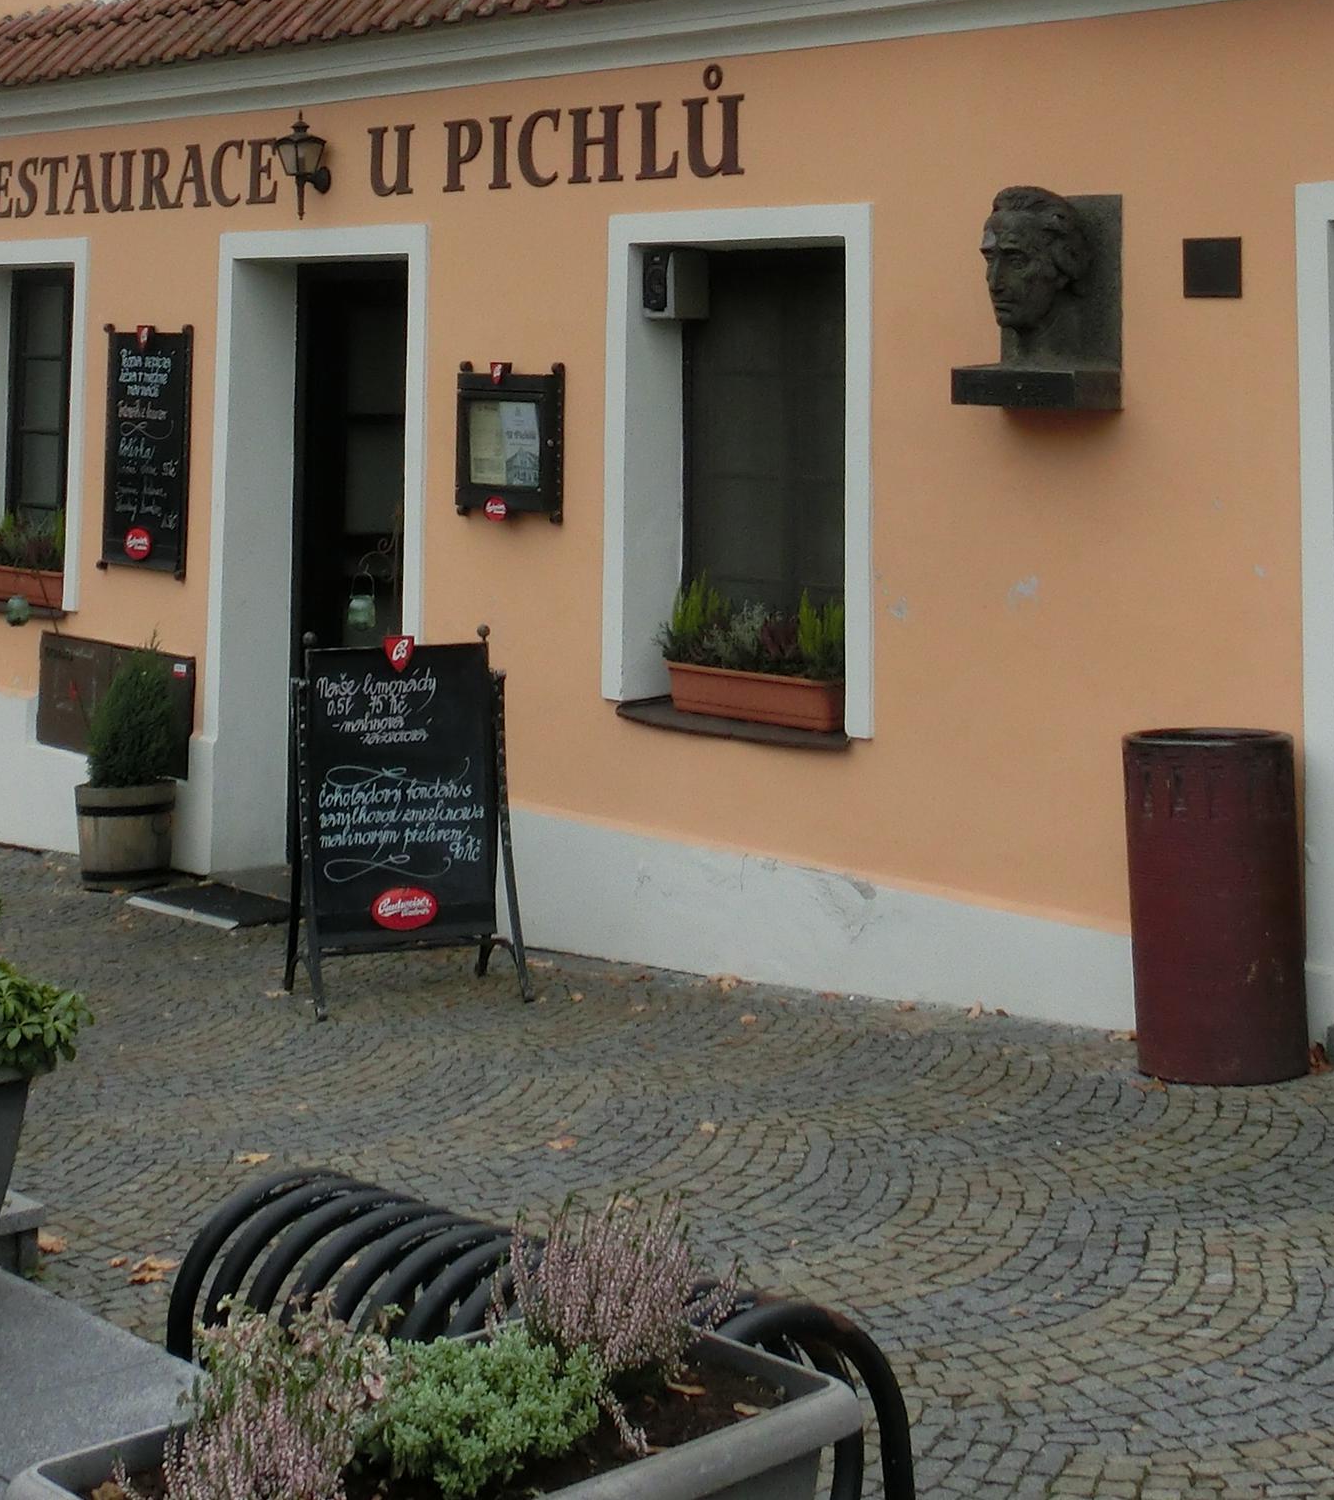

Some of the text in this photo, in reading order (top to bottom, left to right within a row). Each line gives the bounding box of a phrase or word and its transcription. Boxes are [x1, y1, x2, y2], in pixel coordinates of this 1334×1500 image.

[366, 123, 416, 197] U
[442, 63, 746, 193] PICHLŮ
[316, 667, 437, 712] Naše limonády
[318, 781, 402, 809] Čokoládový
